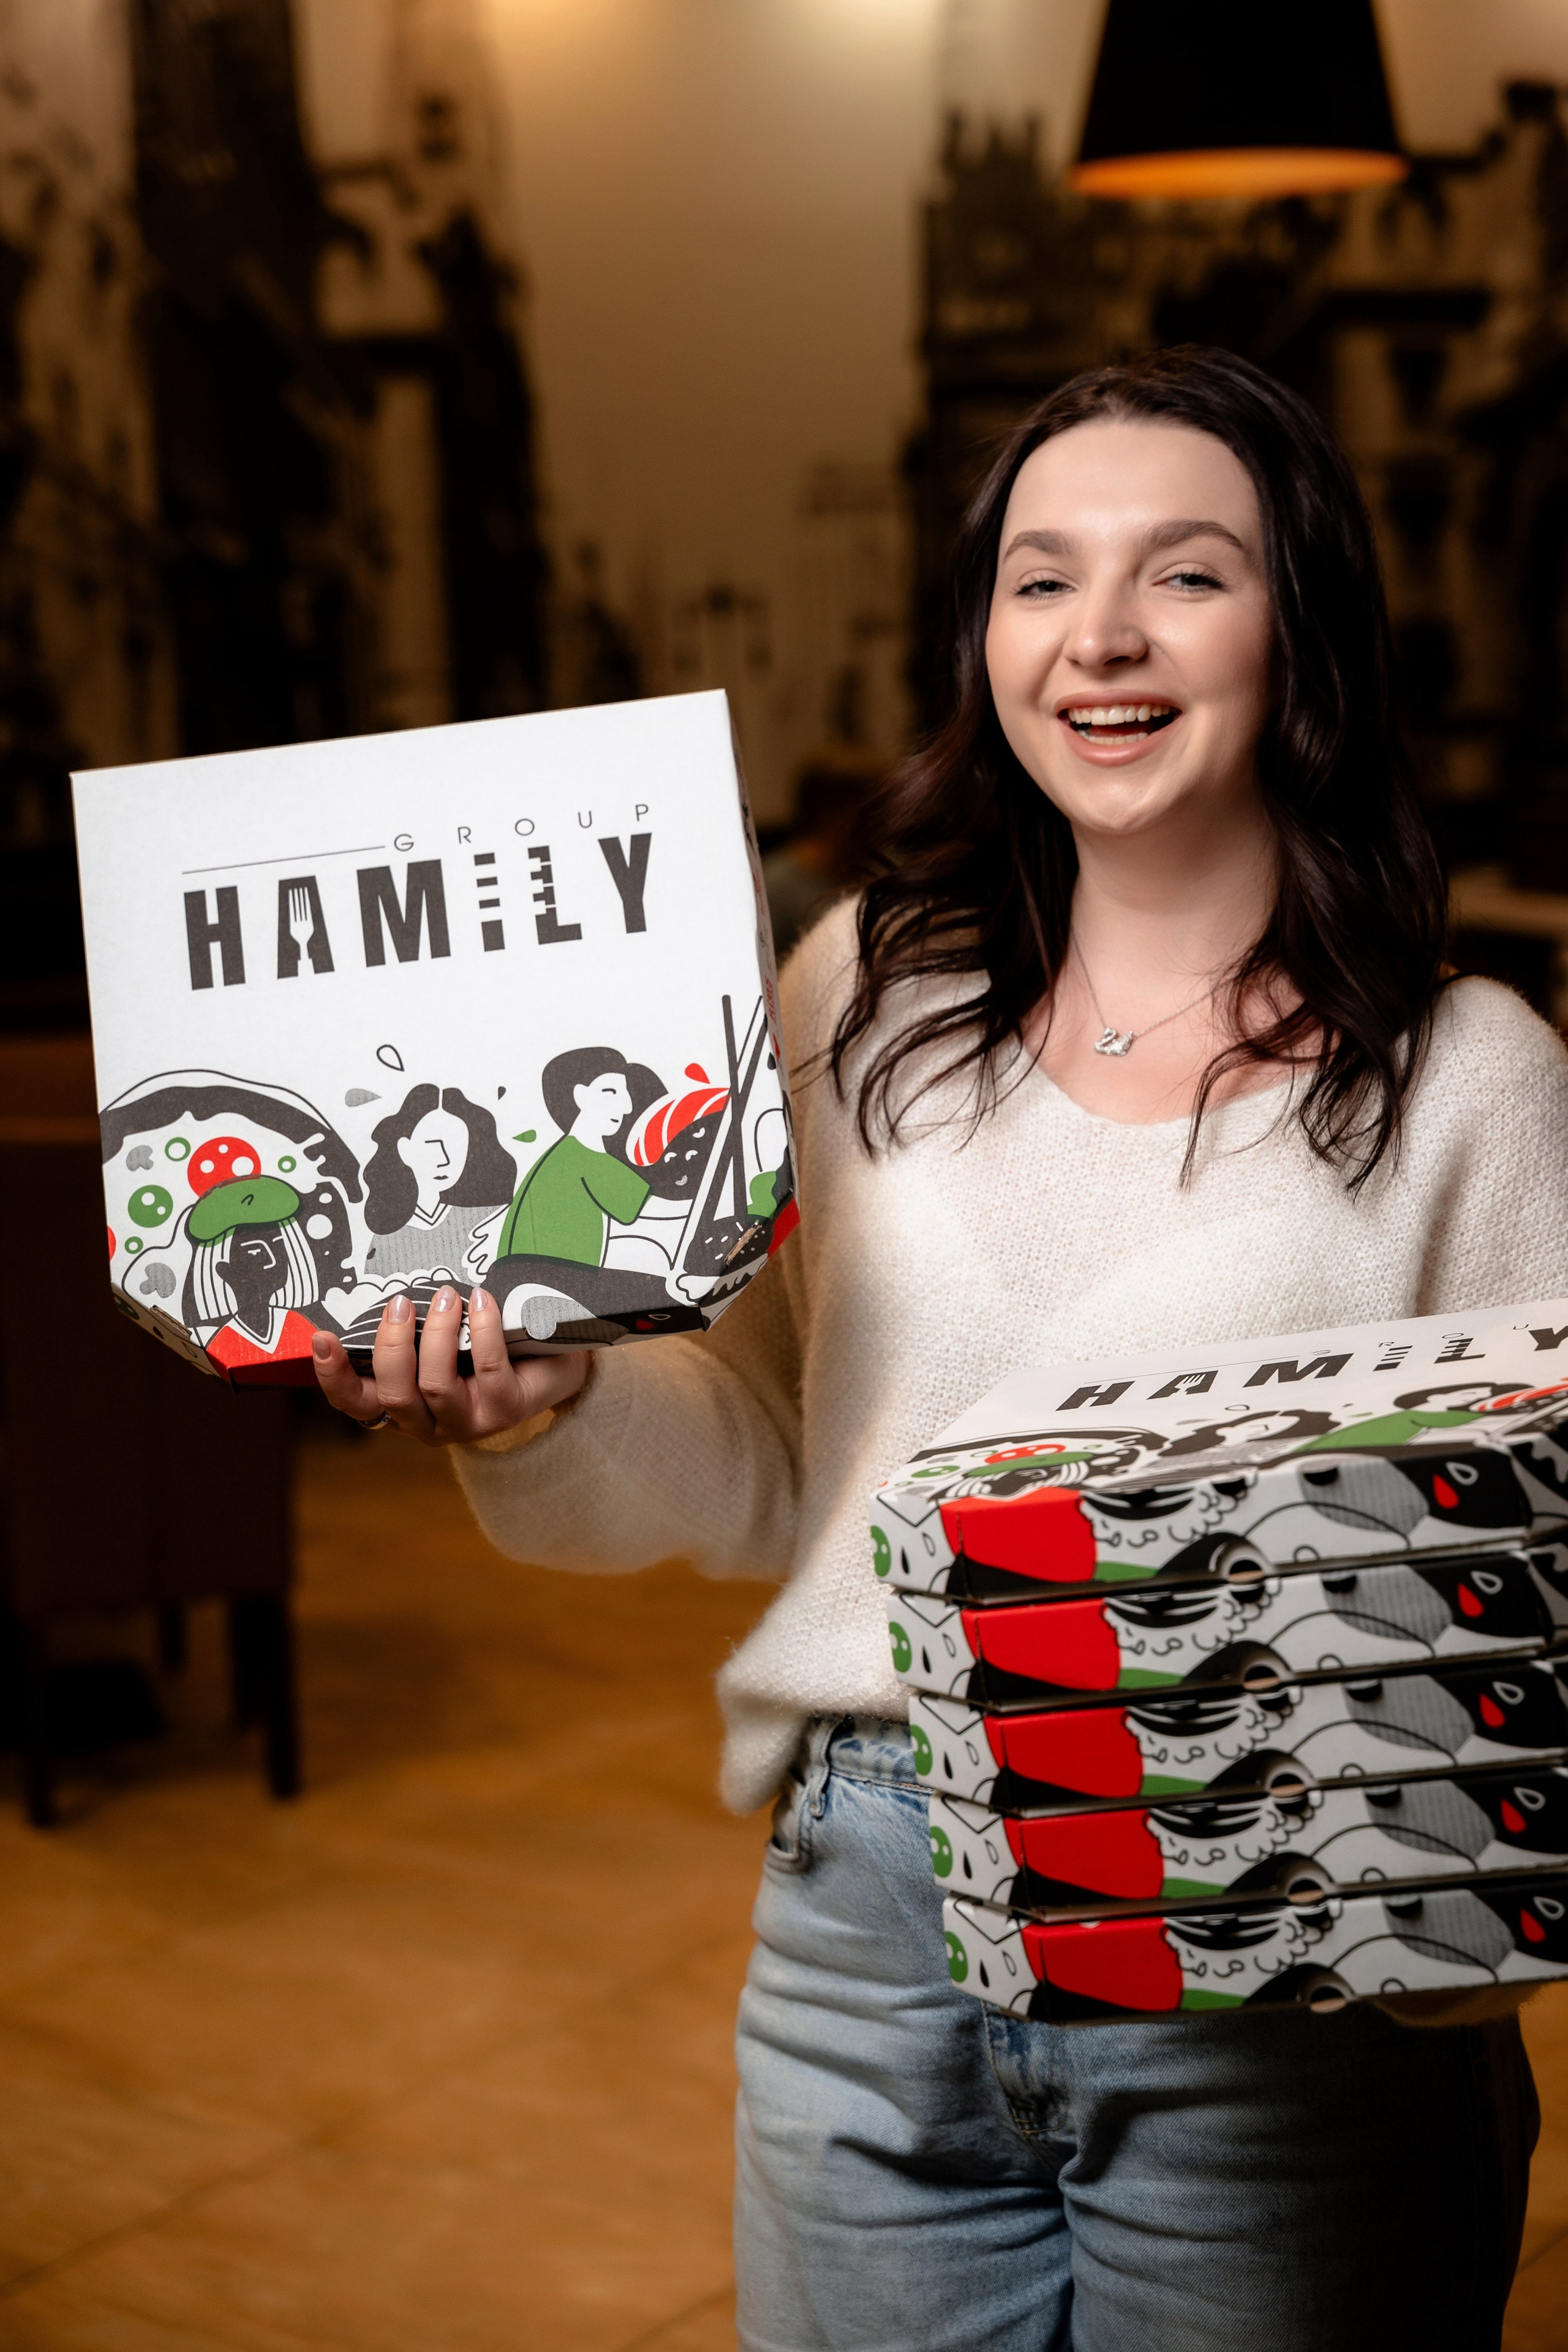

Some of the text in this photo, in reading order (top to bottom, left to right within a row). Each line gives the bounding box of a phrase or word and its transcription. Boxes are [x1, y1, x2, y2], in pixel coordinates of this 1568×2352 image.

[393, 803, 649, 853] GROUP
[183, 832, 653, 992] HAMILY
[1312, 1323, 1530, 1356] GROU
